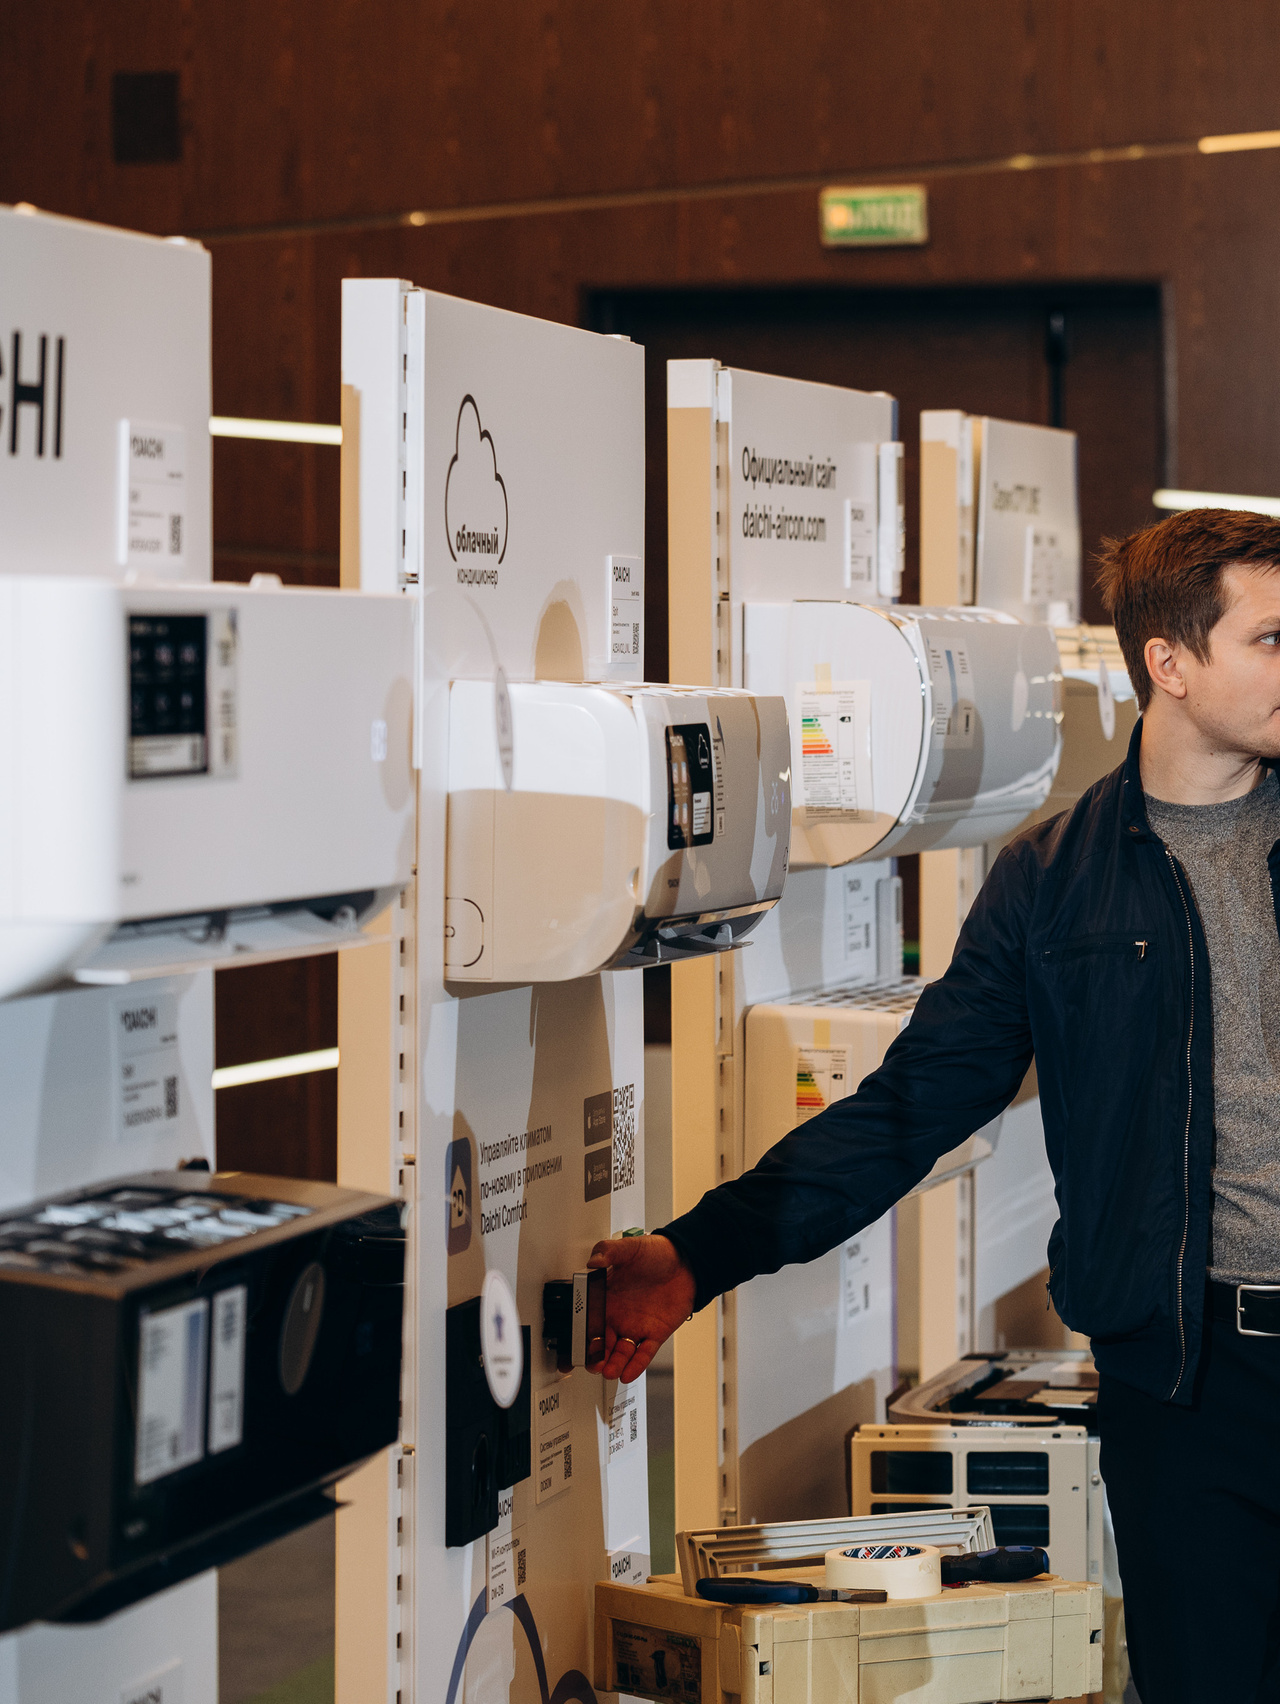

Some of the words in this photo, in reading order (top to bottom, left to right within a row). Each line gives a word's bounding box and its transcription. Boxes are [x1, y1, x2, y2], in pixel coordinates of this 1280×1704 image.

[0, 328, 66, 460] HI
[742, 446, 814, 490] Официальный
[816, 456, 837, 490] сайт
[456, 524, 499, 554] облачный
[742, 503, 827, 542] daichi-aircon.com
[457, 569, 499, 589] кондиционер
[480, 1133, 519, 1166] Управляйте
[519, 1125, 552, 1151] климатом
[480, 1173, 516, 1200] по-новому
[517, 1170, 522, 1187] в
[523, 1155, 563, 1188] приложении
[481, 1206, 501, 1235] Daichi
[502, 1200, 528, 1228] Comfort
[498, 1496, 514, 1518] AICHI
